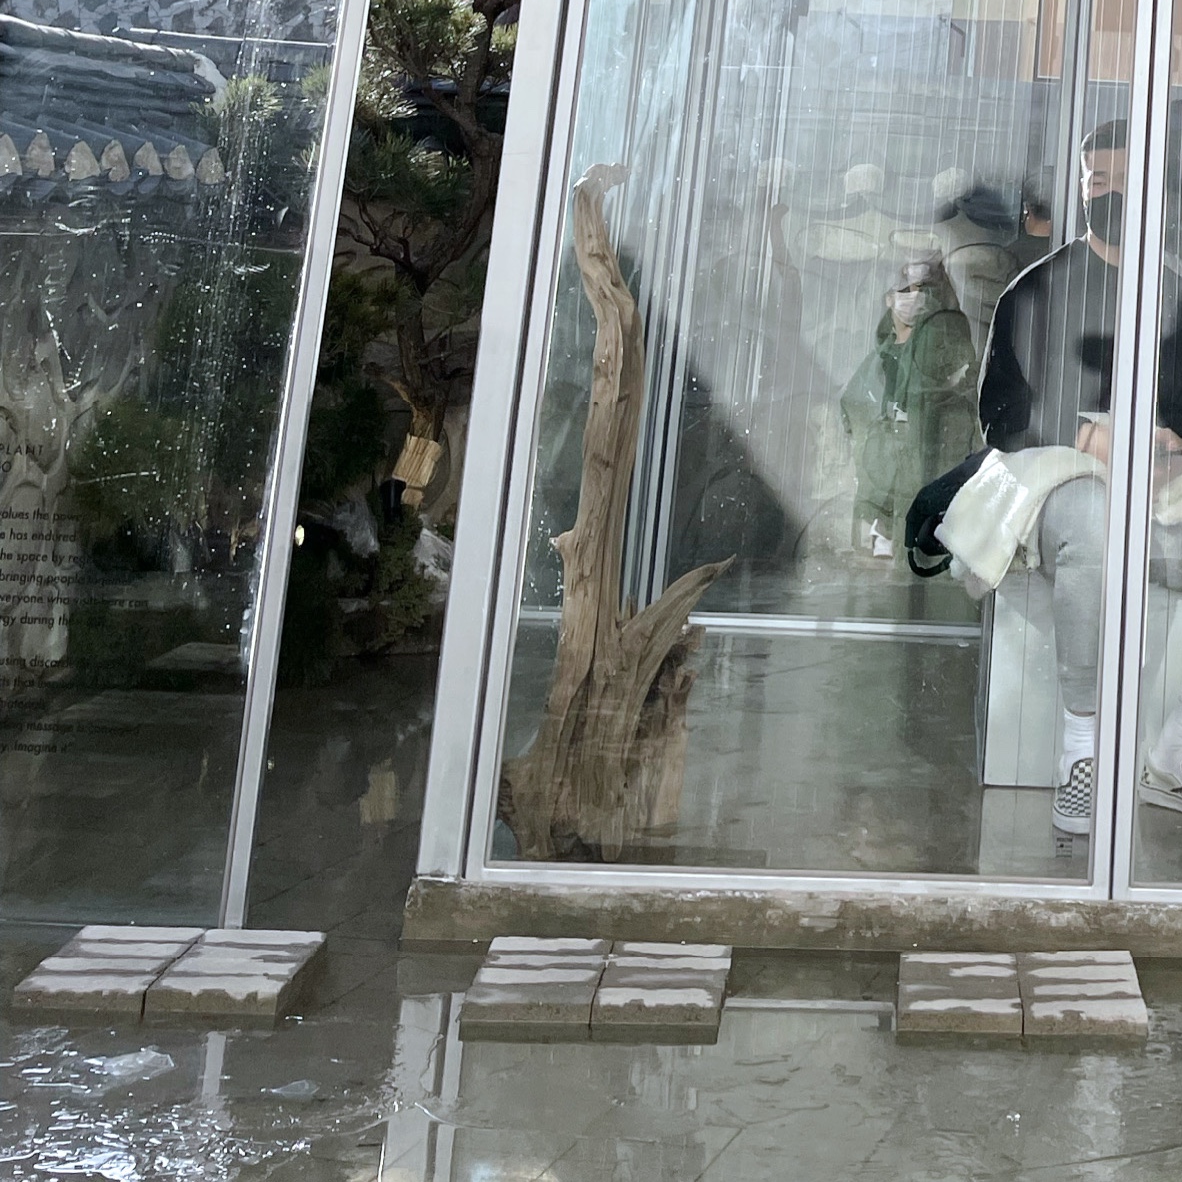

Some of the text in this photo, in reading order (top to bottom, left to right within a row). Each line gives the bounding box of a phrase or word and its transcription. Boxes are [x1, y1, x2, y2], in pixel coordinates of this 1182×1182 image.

[33, 508, 49, 520] the
[10, 528, 28, 540] has
[32, 529, 77, 542] endured
[17, 552, 49, 565] space
[52, 548, 65, 567] by
[47, 591, 70, 605] who
[20, 612, 55, 629] during
